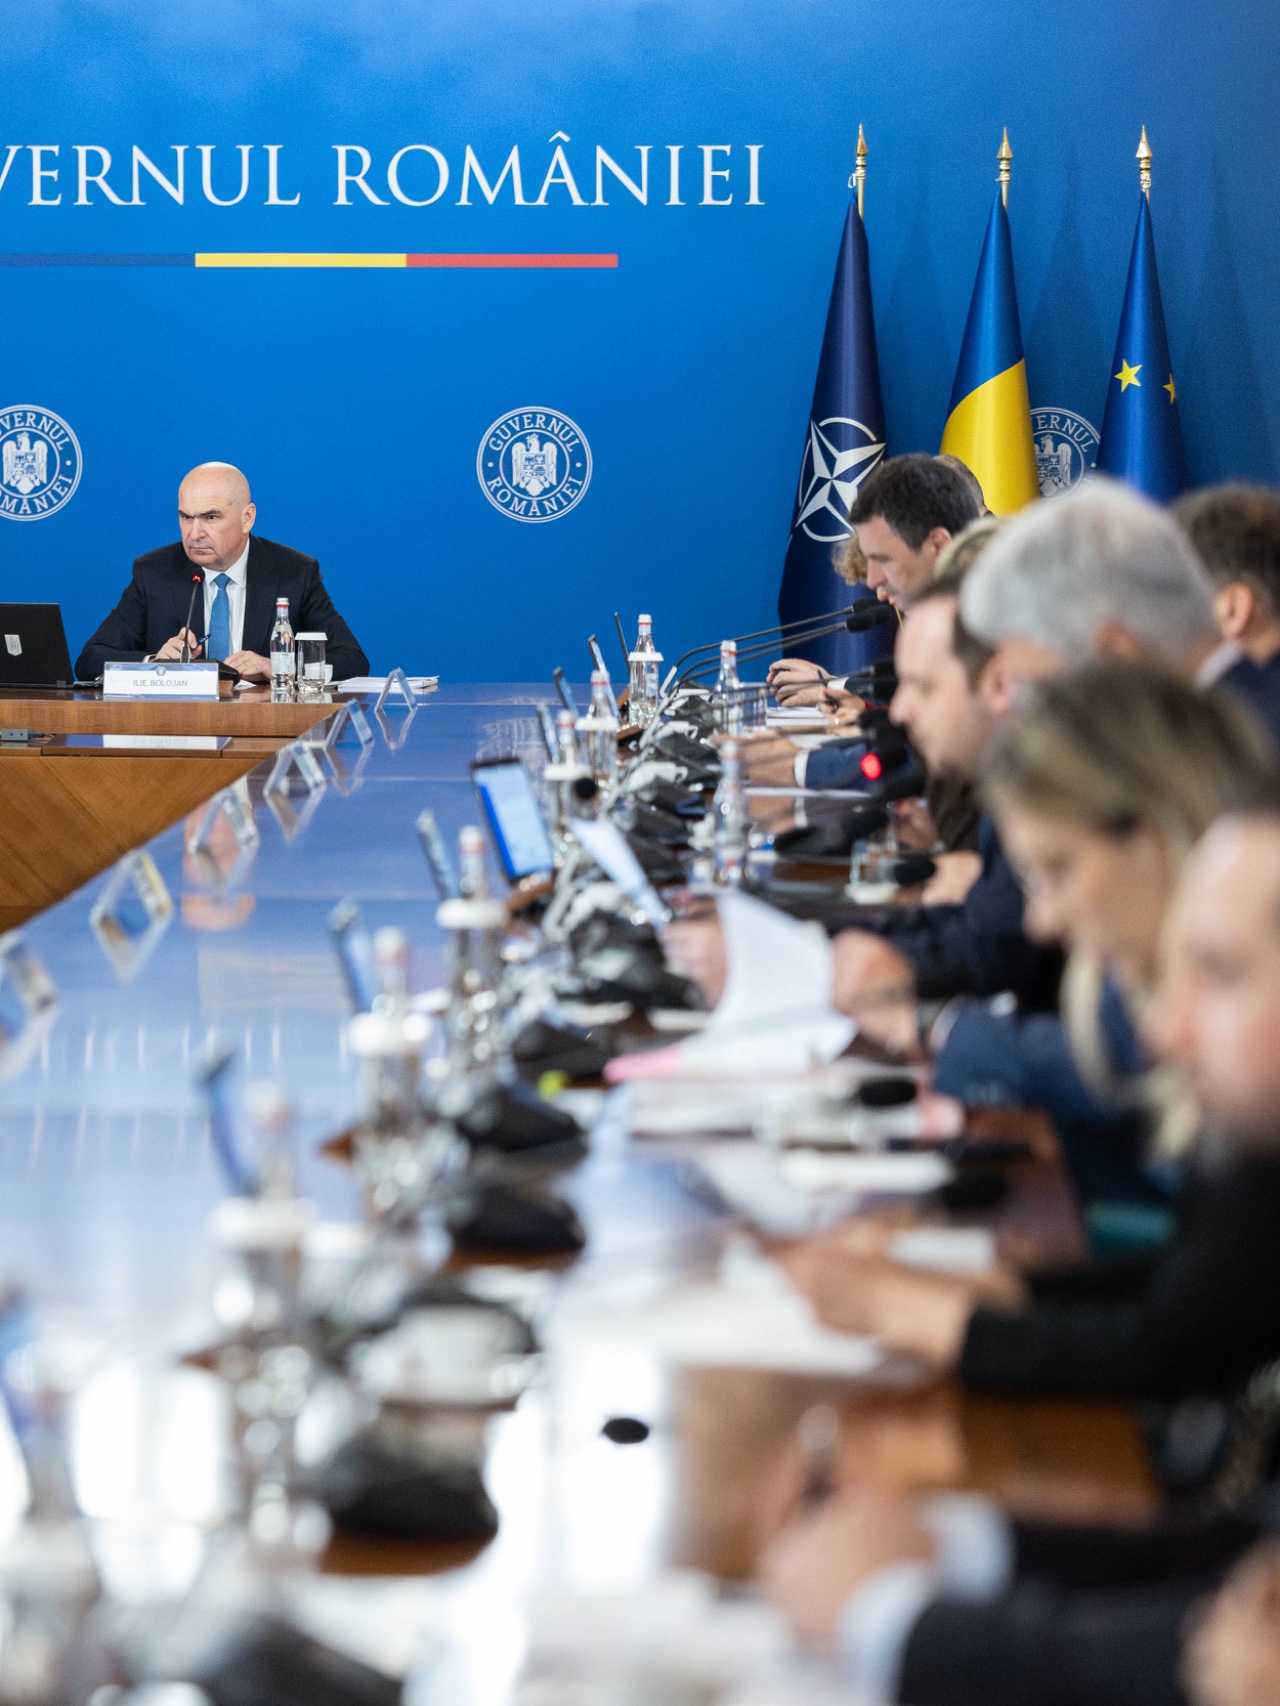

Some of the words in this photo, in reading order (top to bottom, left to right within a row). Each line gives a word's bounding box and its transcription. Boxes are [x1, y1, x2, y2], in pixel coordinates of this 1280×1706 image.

[331, 131, 765, 207] ROMÂNIEI
[489, 414, 580, 452] GUVERNUL
[1031, 414, 1094, 453] ERNUL
[150, 680, 188, 688] BOLOJAN
